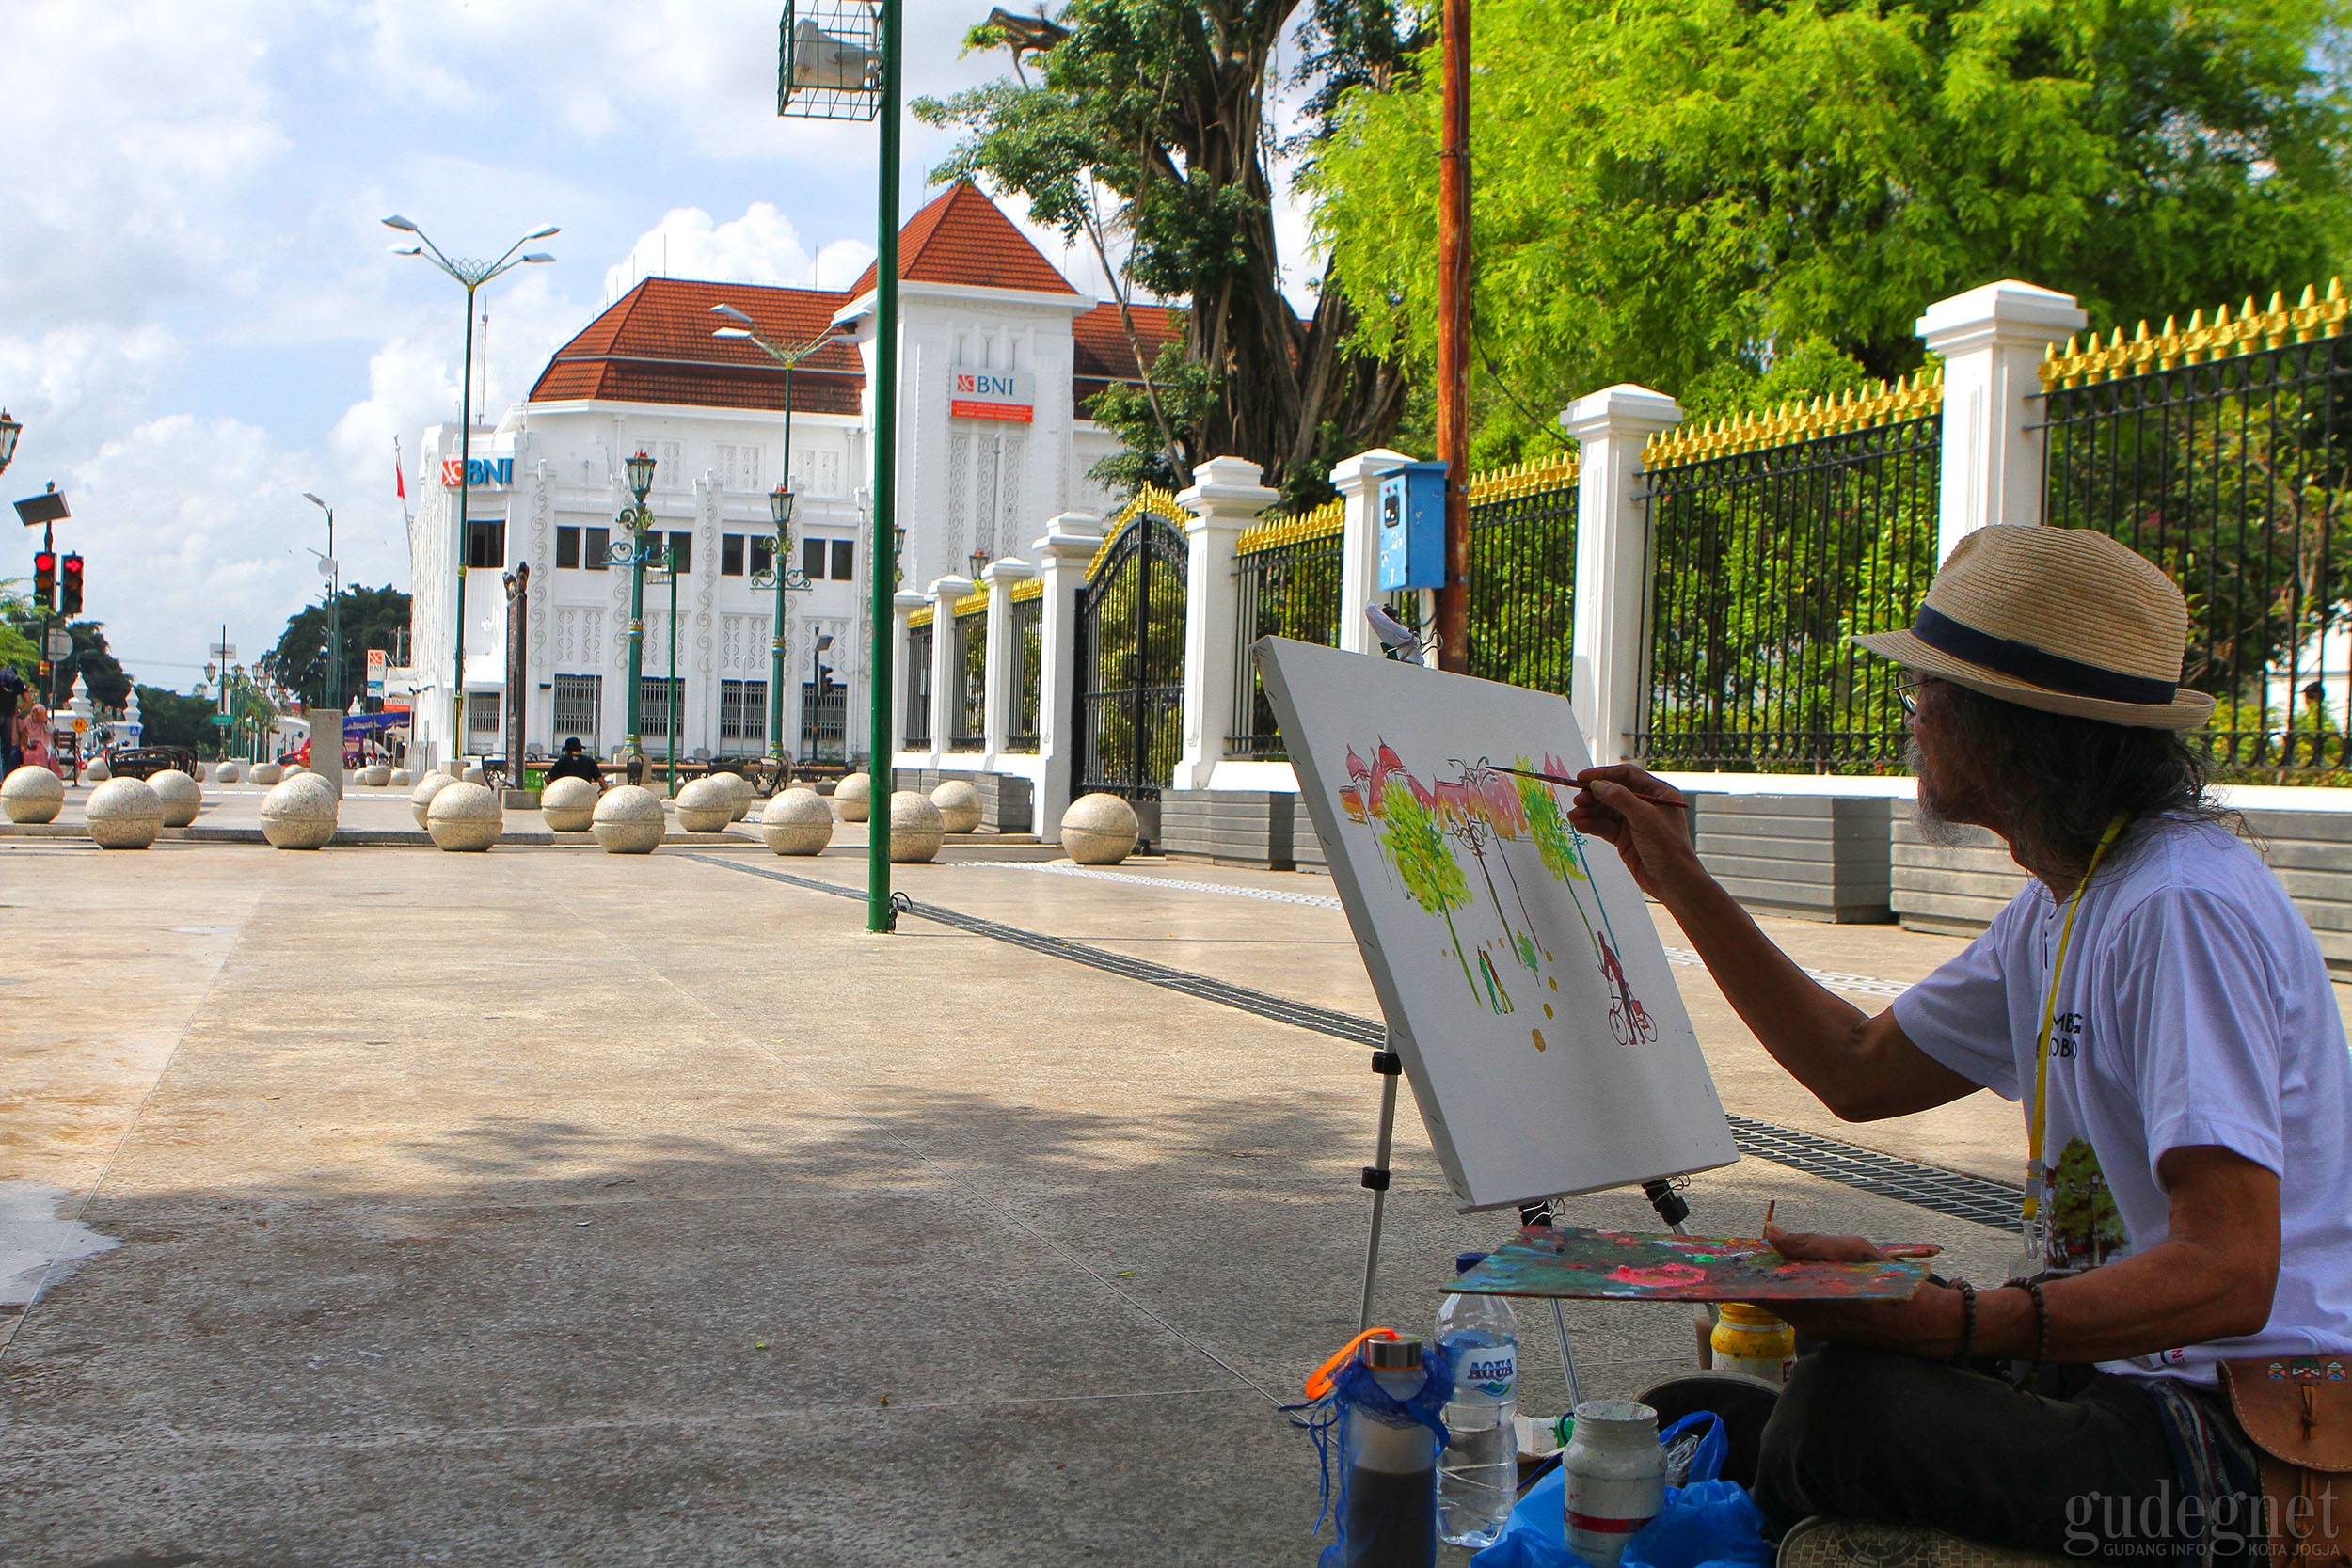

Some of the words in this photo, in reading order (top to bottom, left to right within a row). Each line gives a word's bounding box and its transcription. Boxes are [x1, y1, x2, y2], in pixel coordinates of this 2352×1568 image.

[977, 375, 1014, 396] BNI
[468, 457, 514, 484] BNI
[1468, 1358, 1514, 1382] AQUA
